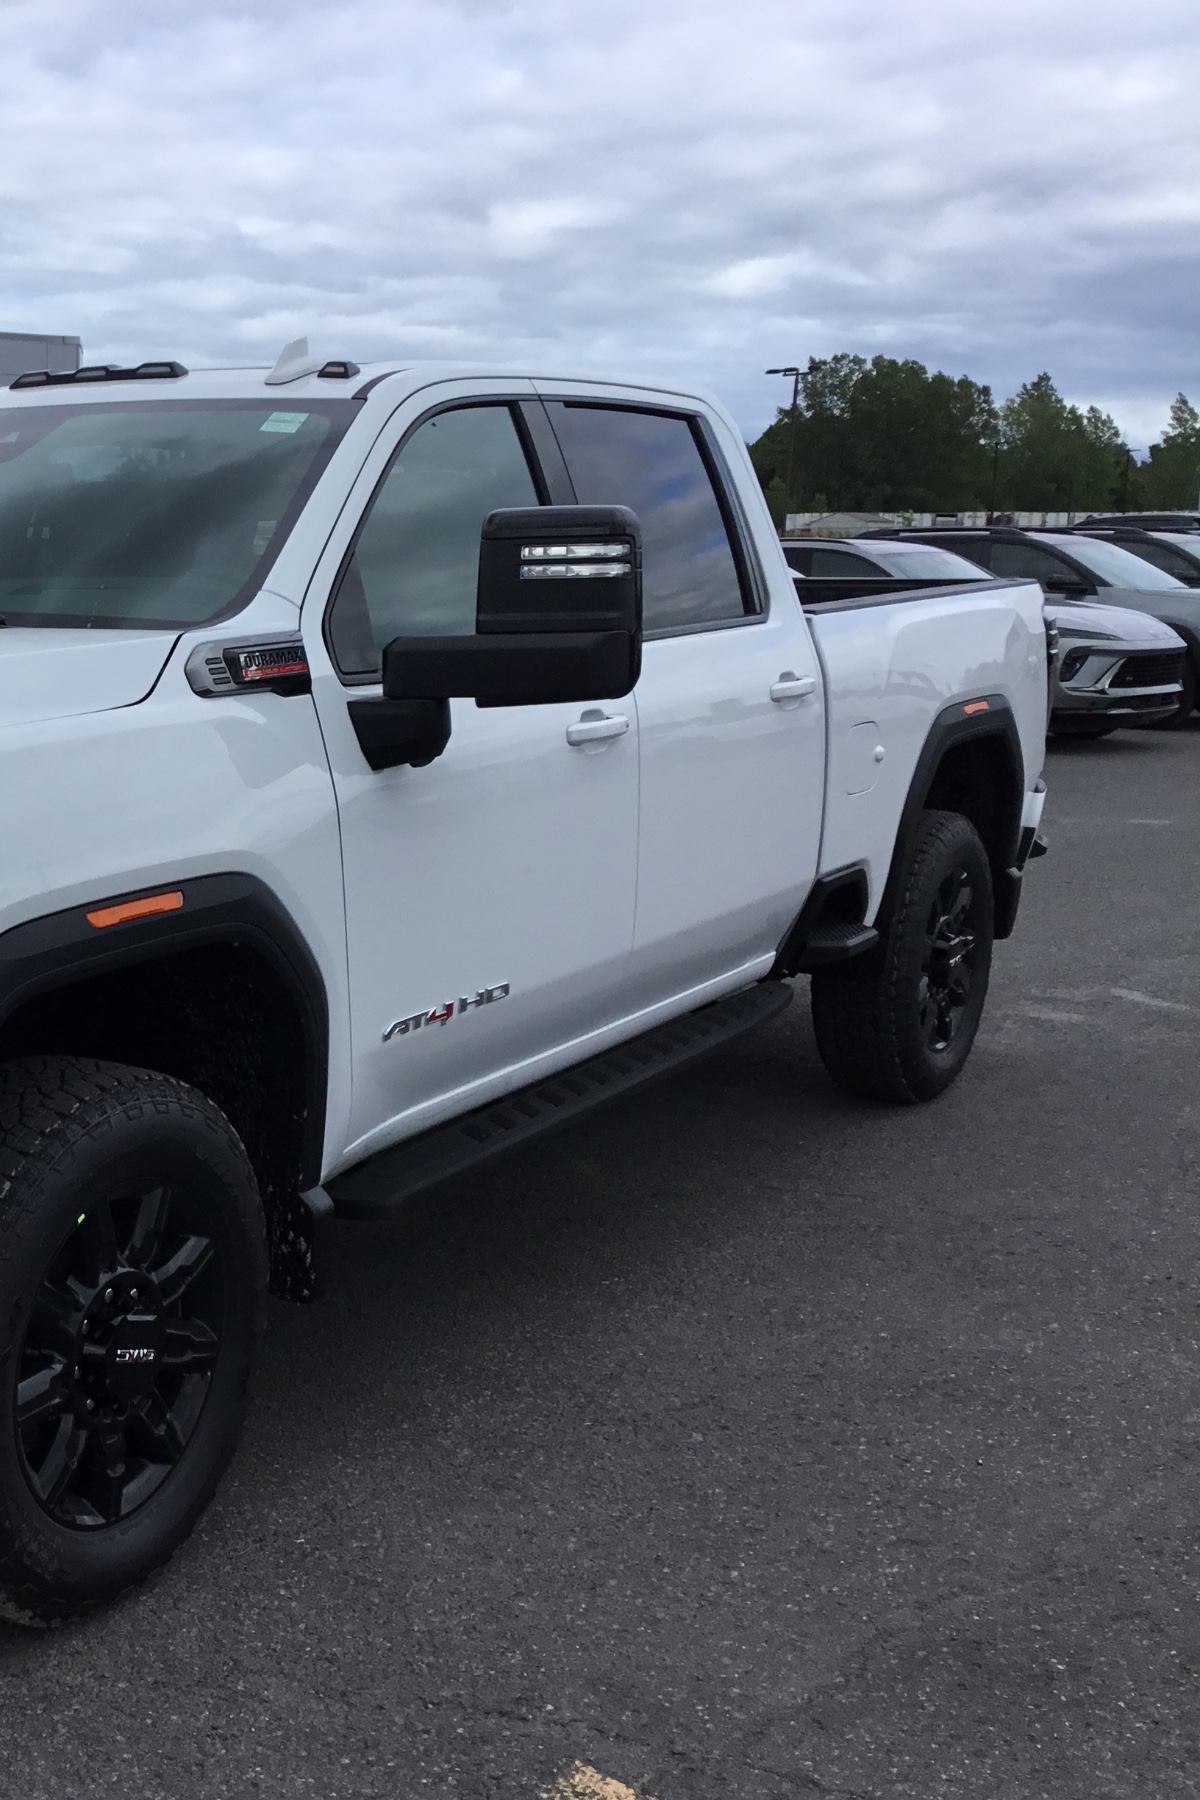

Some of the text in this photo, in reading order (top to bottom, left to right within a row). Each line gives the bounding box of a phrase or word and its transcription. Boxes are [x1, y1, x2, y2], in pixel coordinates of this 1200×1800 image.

[244, 649, 303, 669] DURAMAX
[381, 981, 510, 1043] AT4 HD
